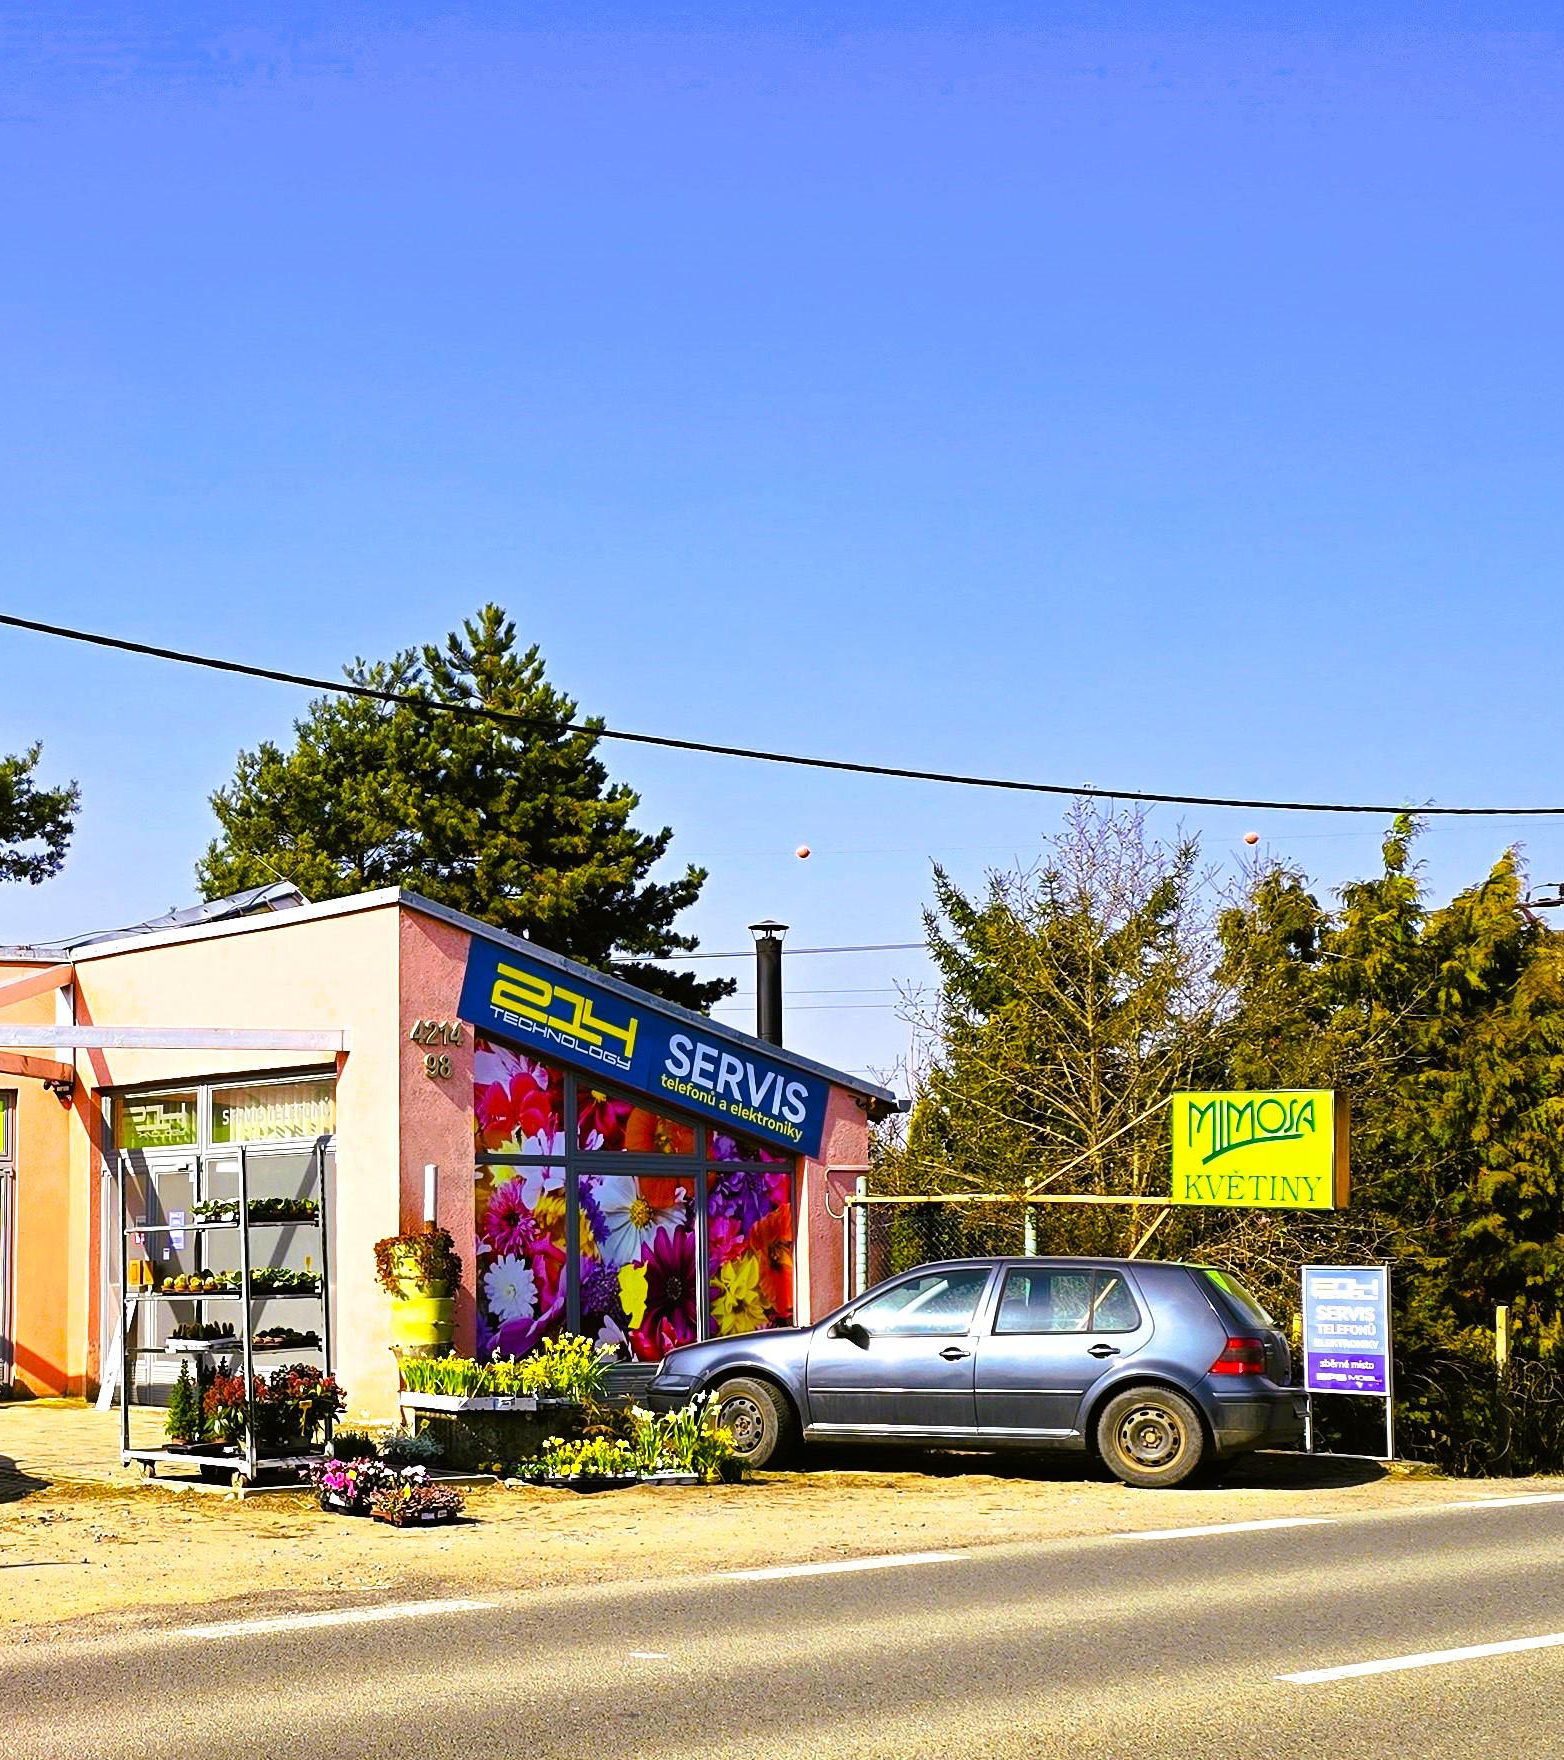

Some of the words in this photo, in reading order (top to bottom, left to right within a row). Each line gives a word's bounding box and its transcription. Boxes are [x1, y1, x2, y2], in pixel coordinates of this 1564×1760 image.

[409, 1019, 464, 1047] 4214
[491, 962, 639, 1058] 214
[489, 1004, 632, 1071] TECHNOLOGY
[422, 1053, 453, 1079] 98
[664, 1033, 809, 1124] SERVIS
[660, 1073, 716, 1106] telefonů
[718, 1098, 728, 1111] a
[730, 1102, 804, 1143] elektroniky
[1188, 1098, 1316, 1166] MIMOSA
[1184, 1170, 1323, 1202] KVĚTINY
[1315, 1304, 1376, 1322] SERVIS
[1316, 1322, 1377, 1336] TELEFONŮ
